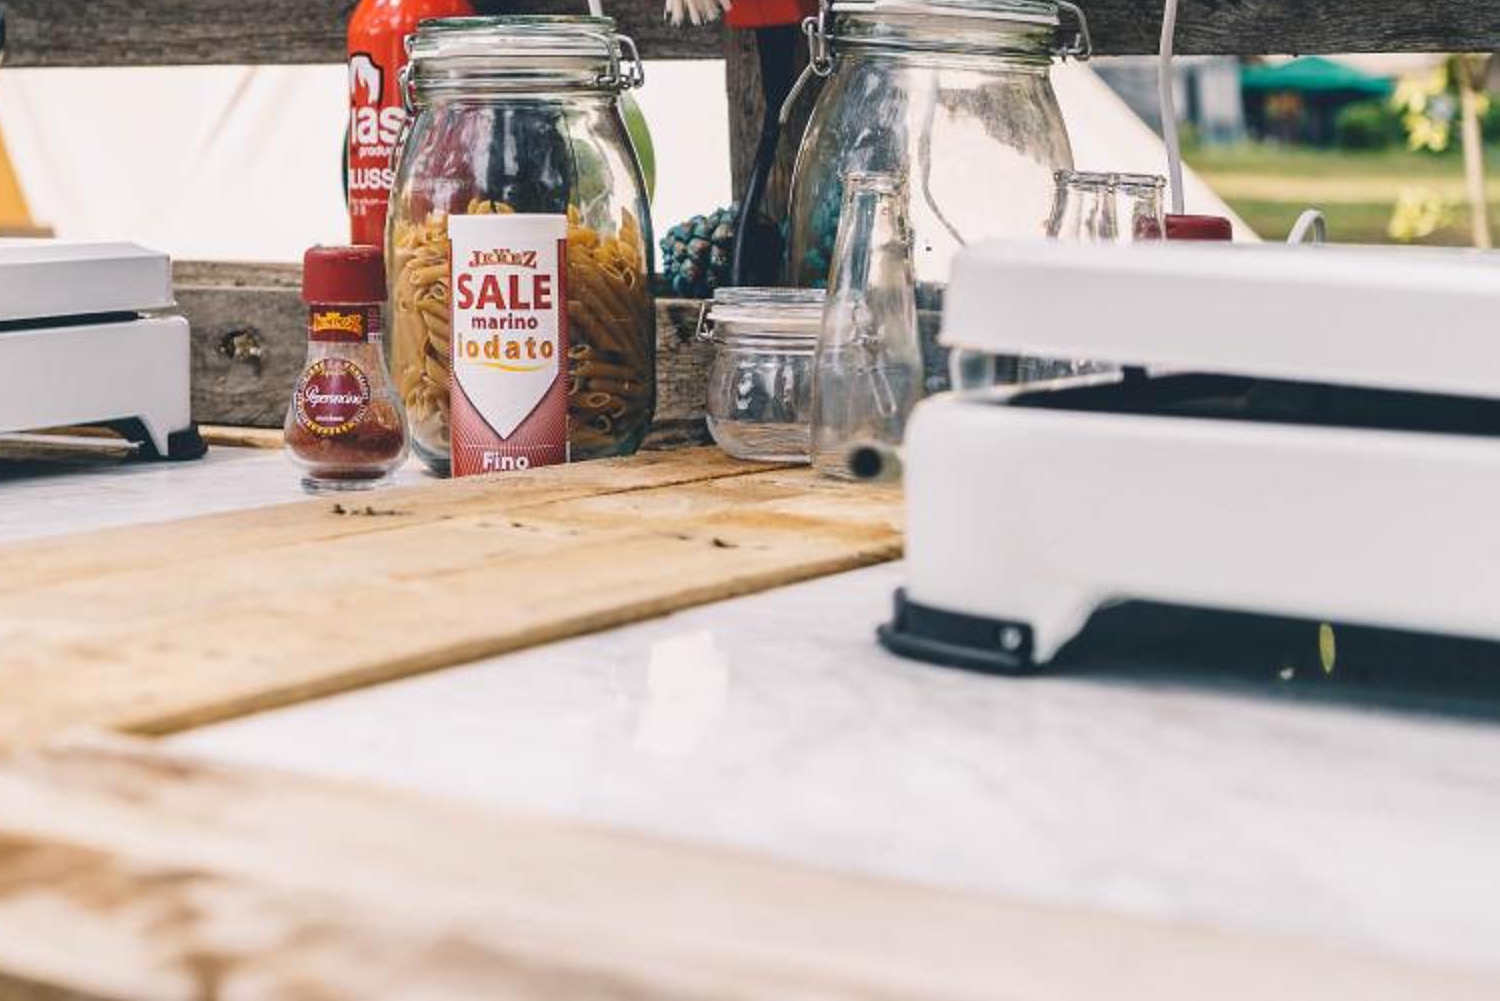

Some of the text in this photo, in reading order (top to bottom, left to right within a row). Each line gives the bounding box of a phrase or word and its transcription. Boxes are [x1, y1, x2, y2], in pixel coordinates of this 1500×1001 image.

[457, 273, 552, 310] SALE
[471, 312, 538, 330] marino
[457, 333, 554, 360] iodato
[483, 451, 530, 471] Fino
